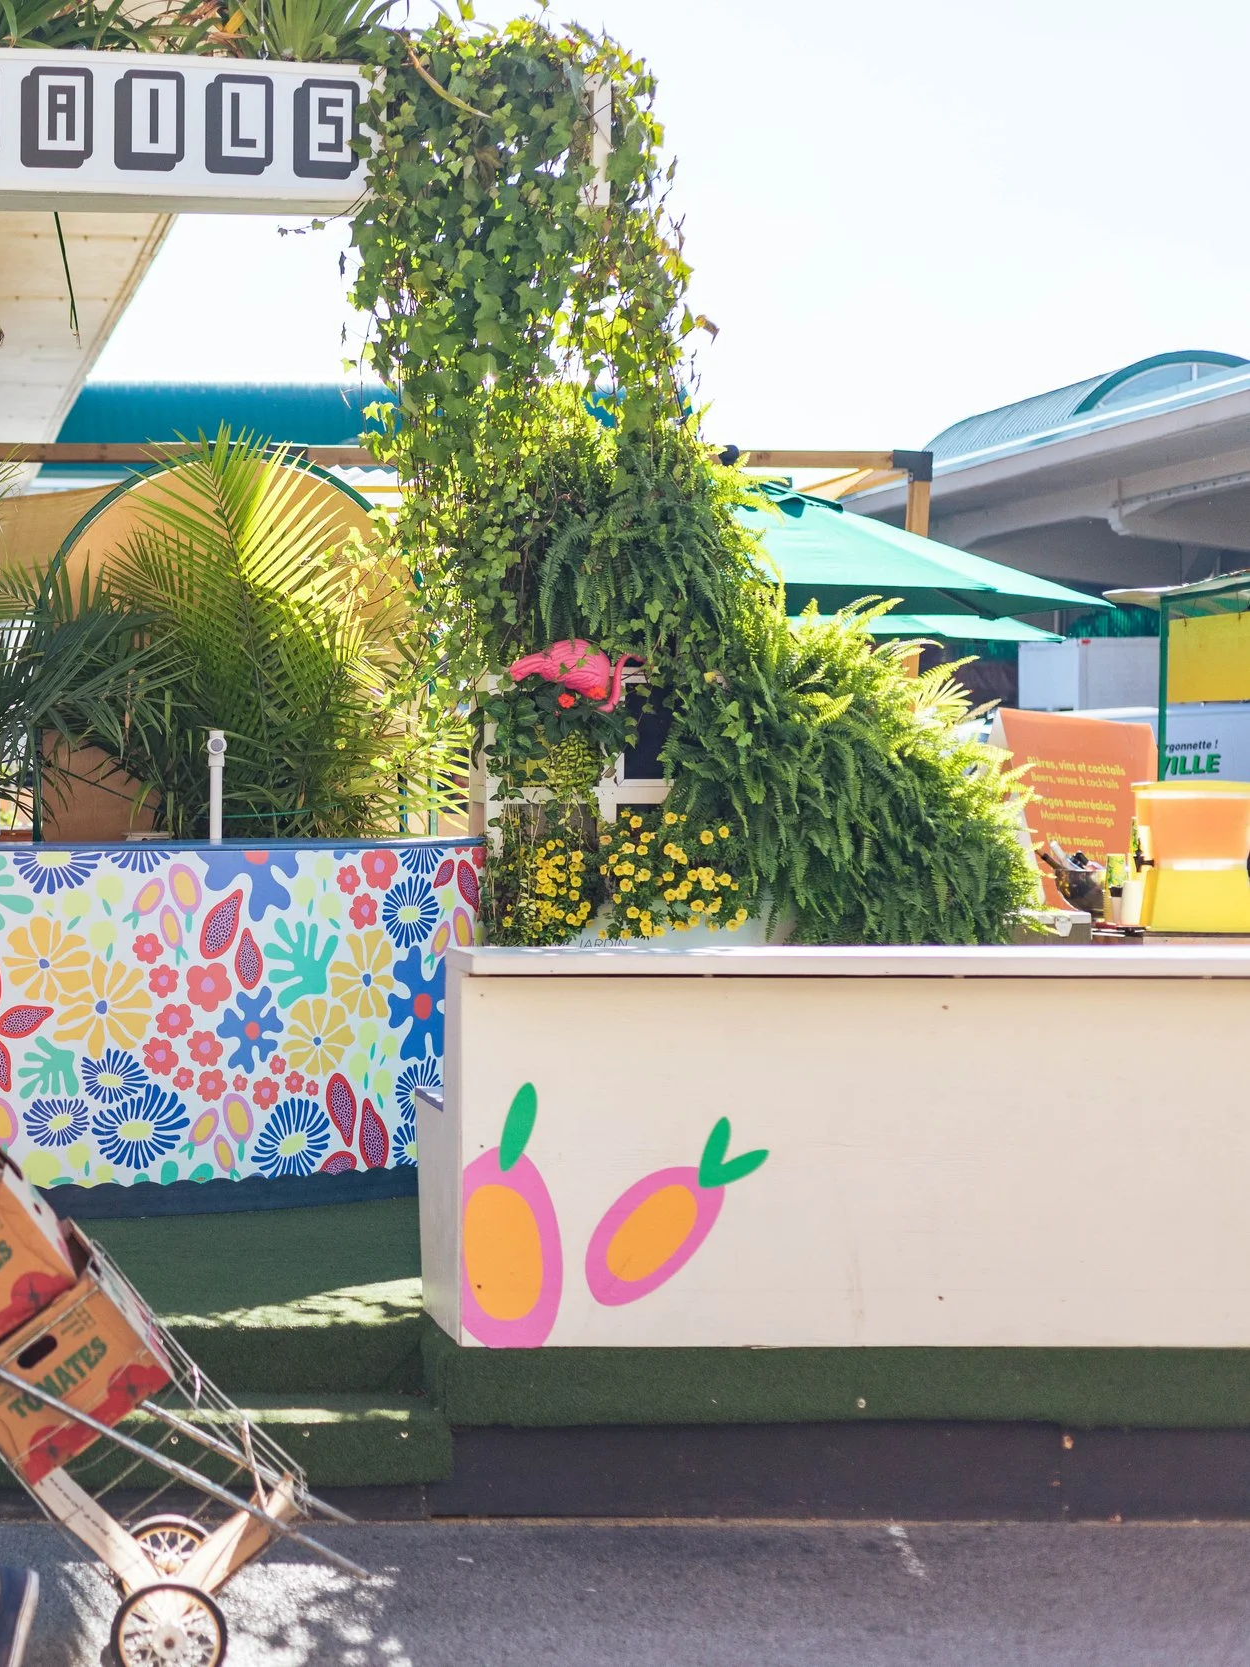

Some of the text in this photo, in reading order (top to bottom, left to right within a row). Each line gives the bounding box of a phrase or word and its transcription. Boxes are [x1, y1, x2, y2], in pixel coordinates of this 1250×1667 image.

[1164, 740, 1212, 753] rgonnette
[1058, 760, 1076, 772] vins
[1077, 762, 1086, 772] et
[1088, 763, 1126, 776] cocktails
[1056, 774, 1078, 785] wines
[1086, 777, 1119, 789] cocktails
[1037, 797, 1117, 812] ogos montréalais
[1040, 810, 1114, 828] Montreal corn dogs
[1073, 836, 1104, 848] maison
